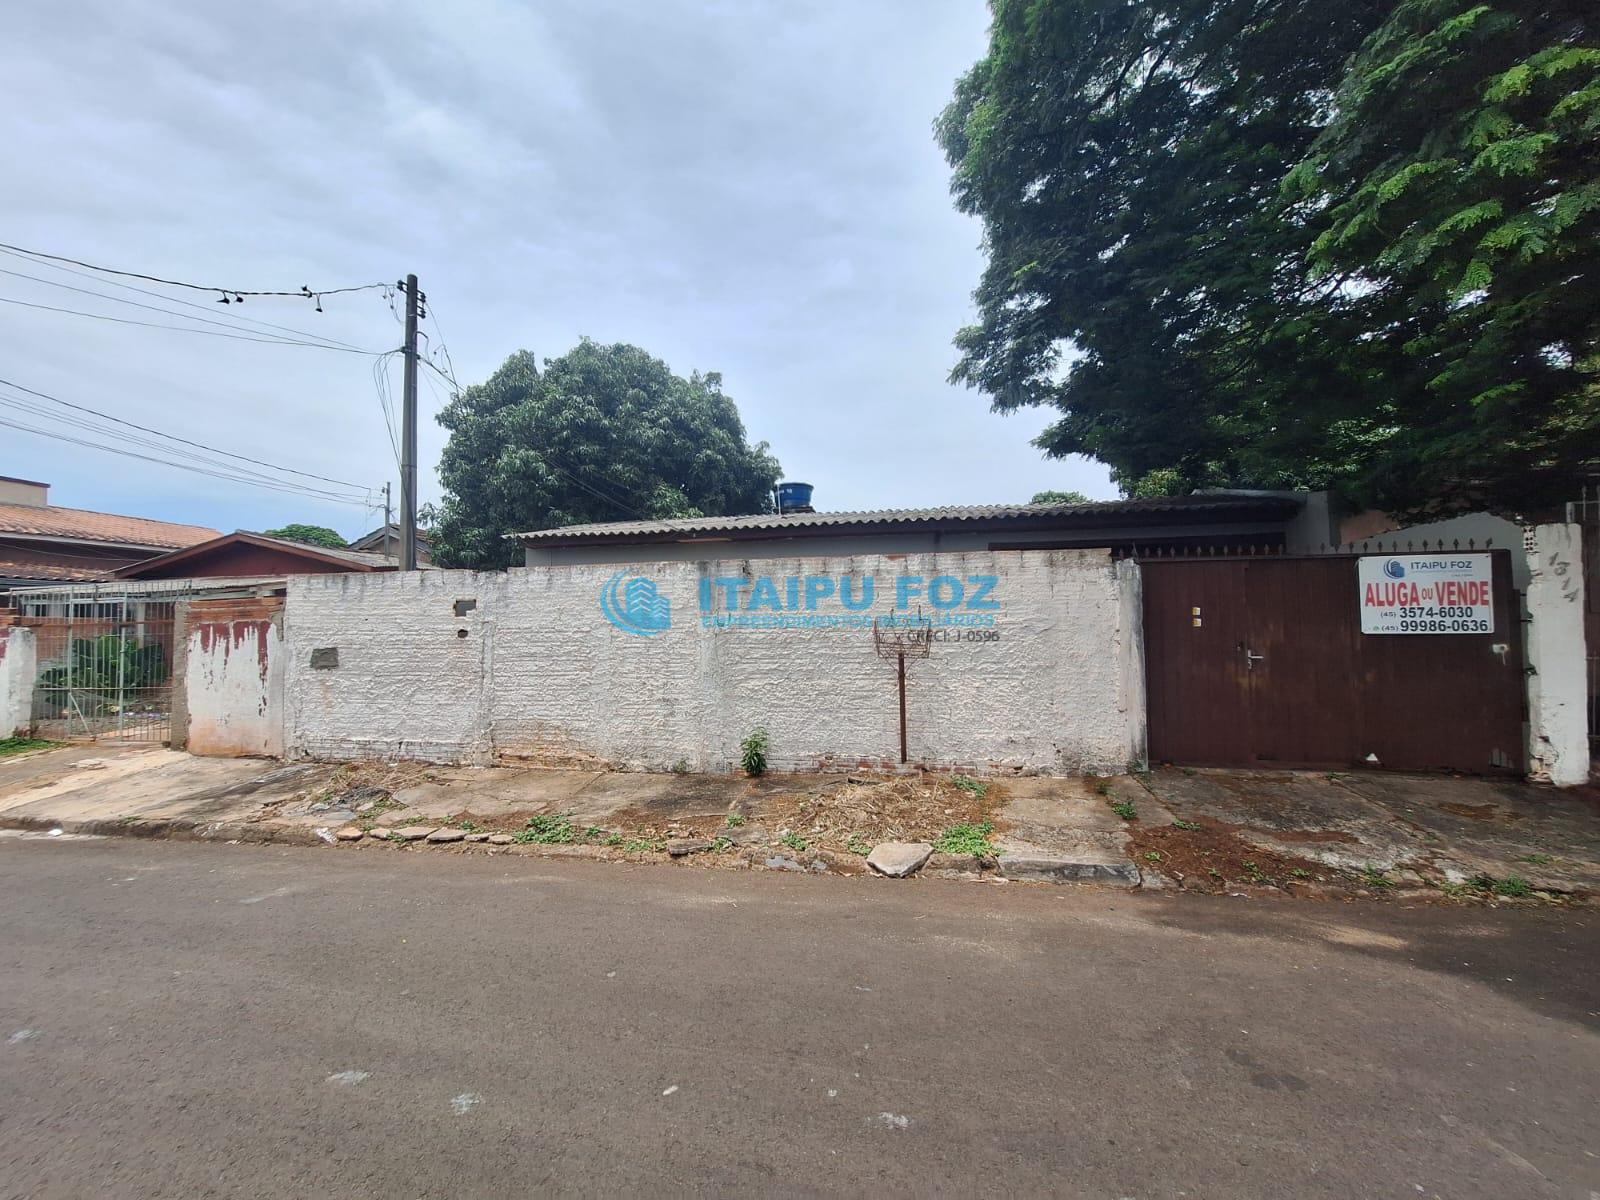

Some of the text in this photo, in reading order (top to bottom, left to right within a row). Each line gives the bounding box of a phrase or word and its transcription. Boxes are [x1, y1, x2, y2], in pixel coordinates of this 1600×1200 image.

[1410, 560, 1473, 570] ITAIPU FOZ
[1365, 582, 1420, 607] ALUGA
[1435, 581, 1490, 606] VENDE
[1399, 606, 1473, 618] 3574-6030
[1400, 619, 1489, 632] 99986-0636
